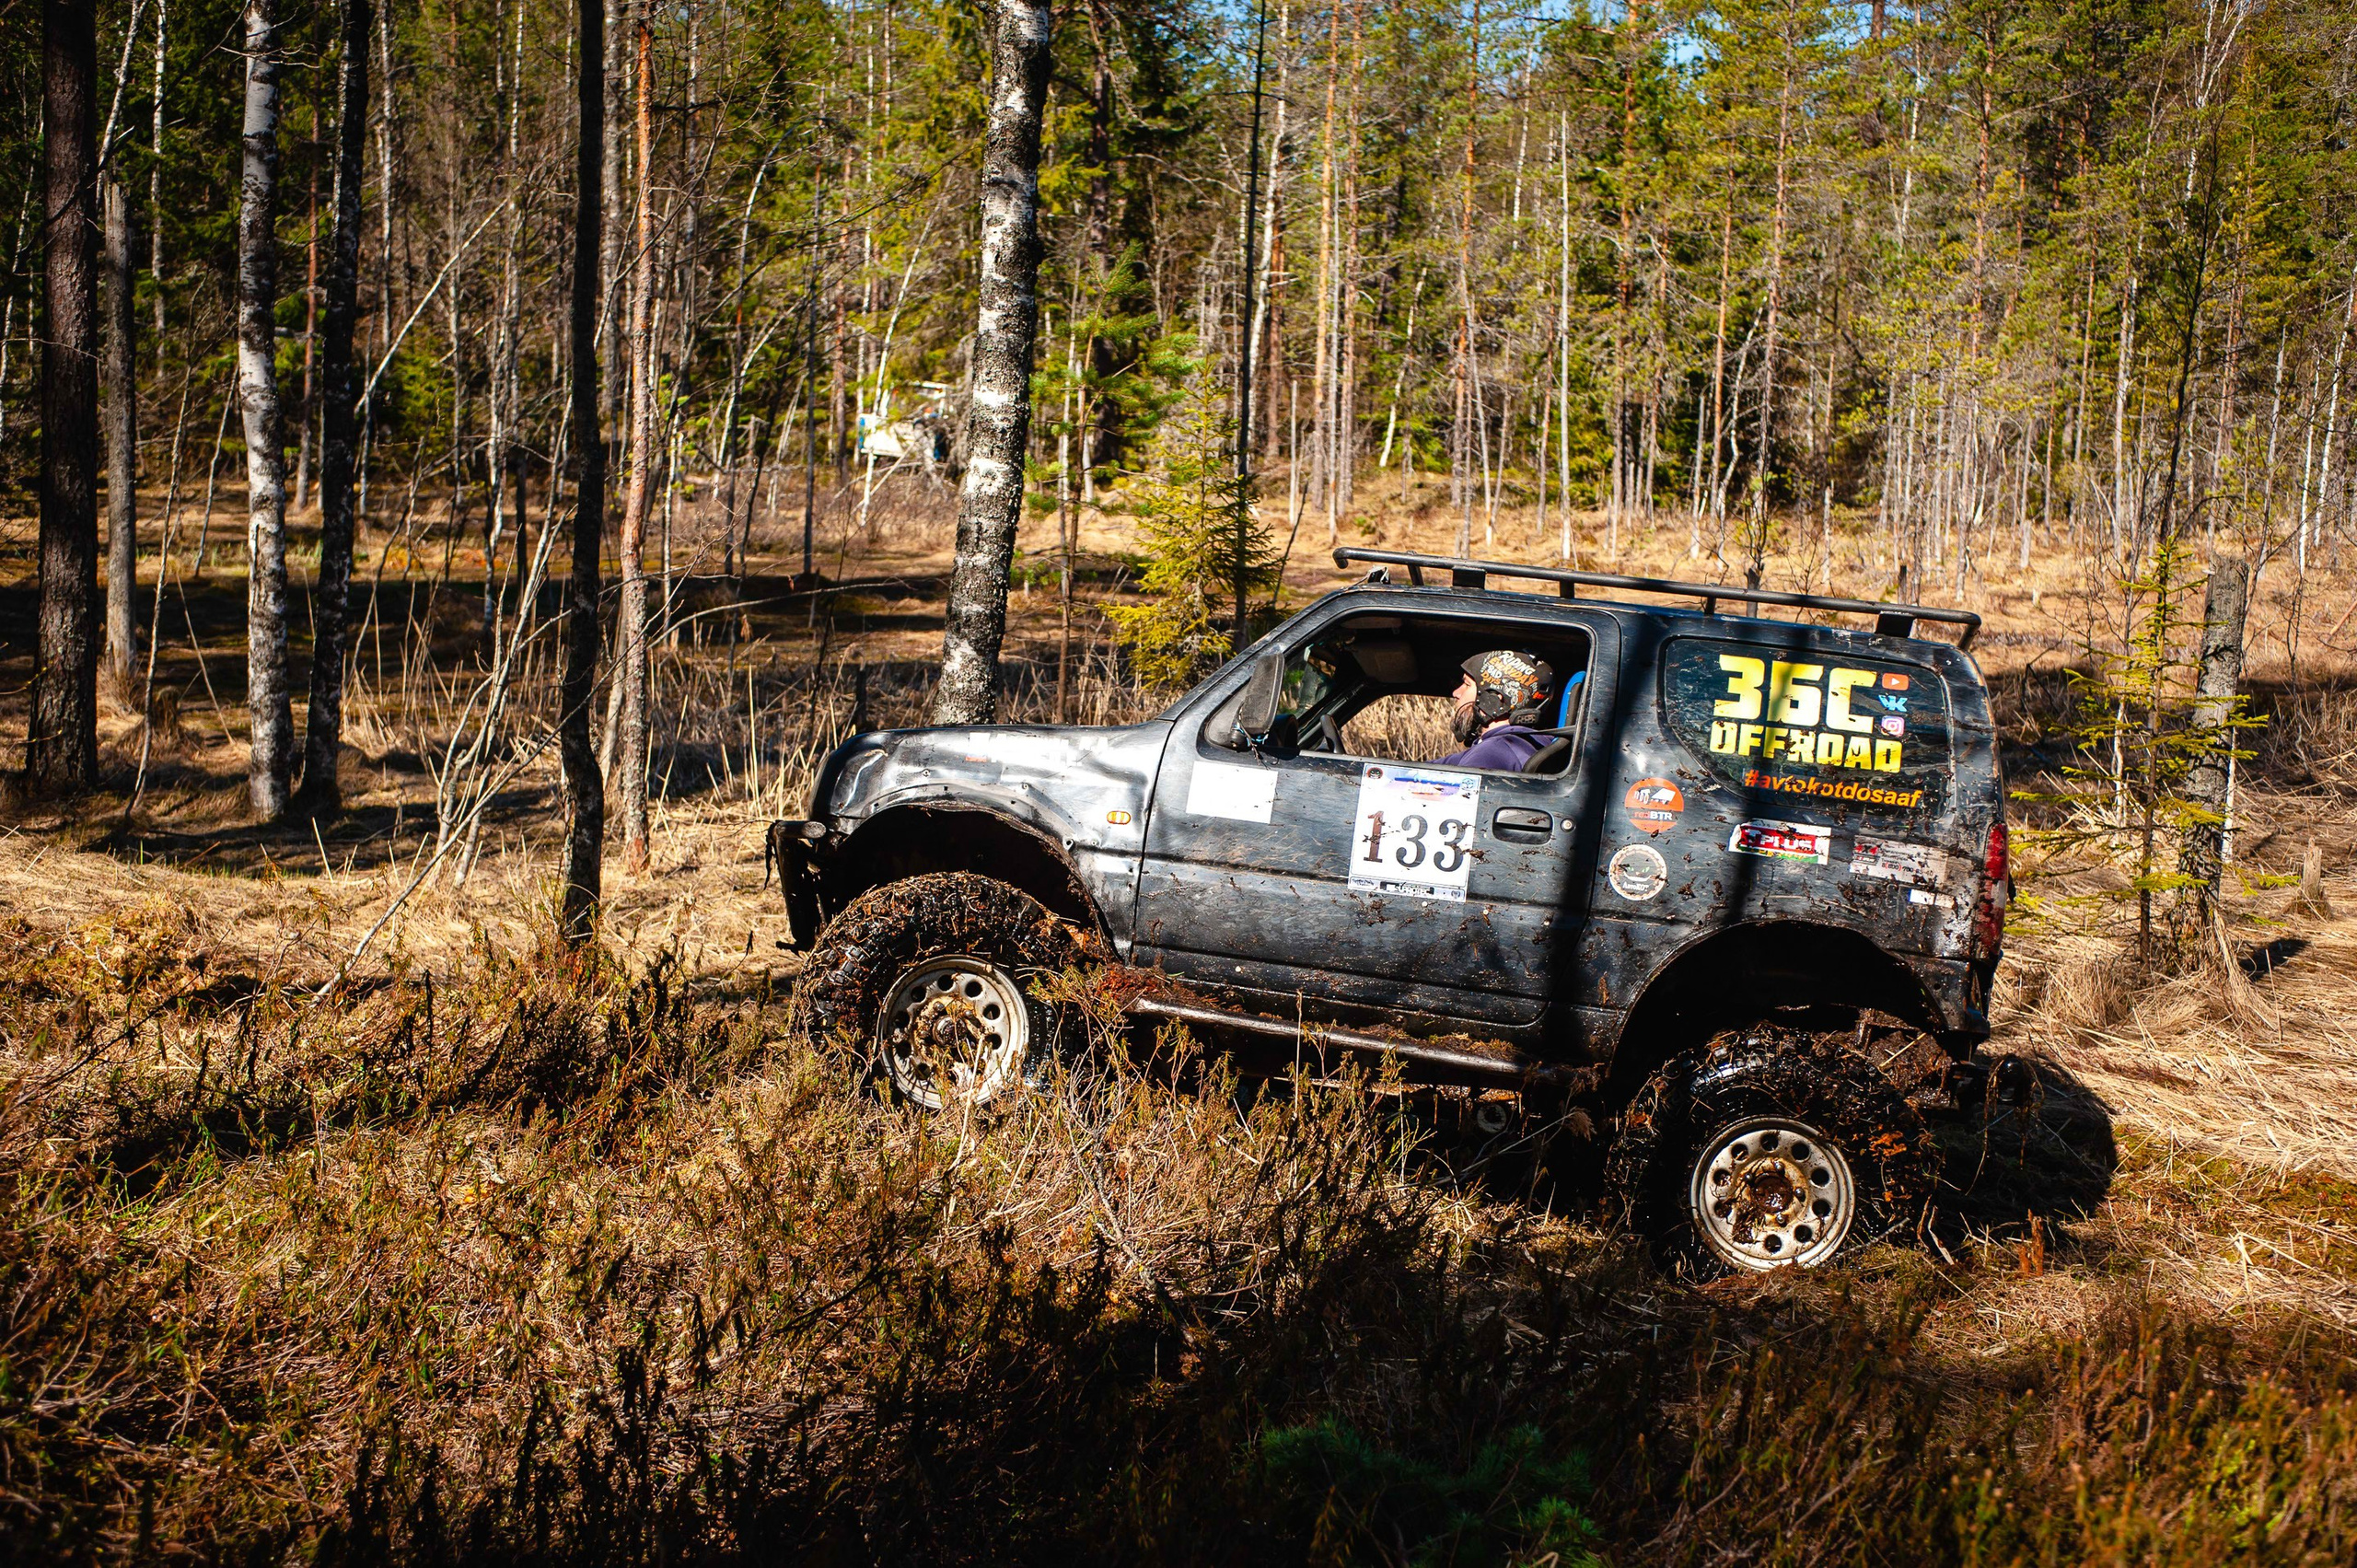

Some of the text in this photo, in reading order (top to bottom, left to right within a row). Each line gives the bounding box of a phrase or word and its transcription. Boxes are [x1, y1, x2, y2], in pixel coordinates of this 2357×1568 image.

[1498, 650, 1536, 675] RIDING
[1710, 721, 1902, 773] OFFROAD
[1745, 769, 1923, 807] #avtokotdosaaf
[1363, 810, 1465, 873] 133
